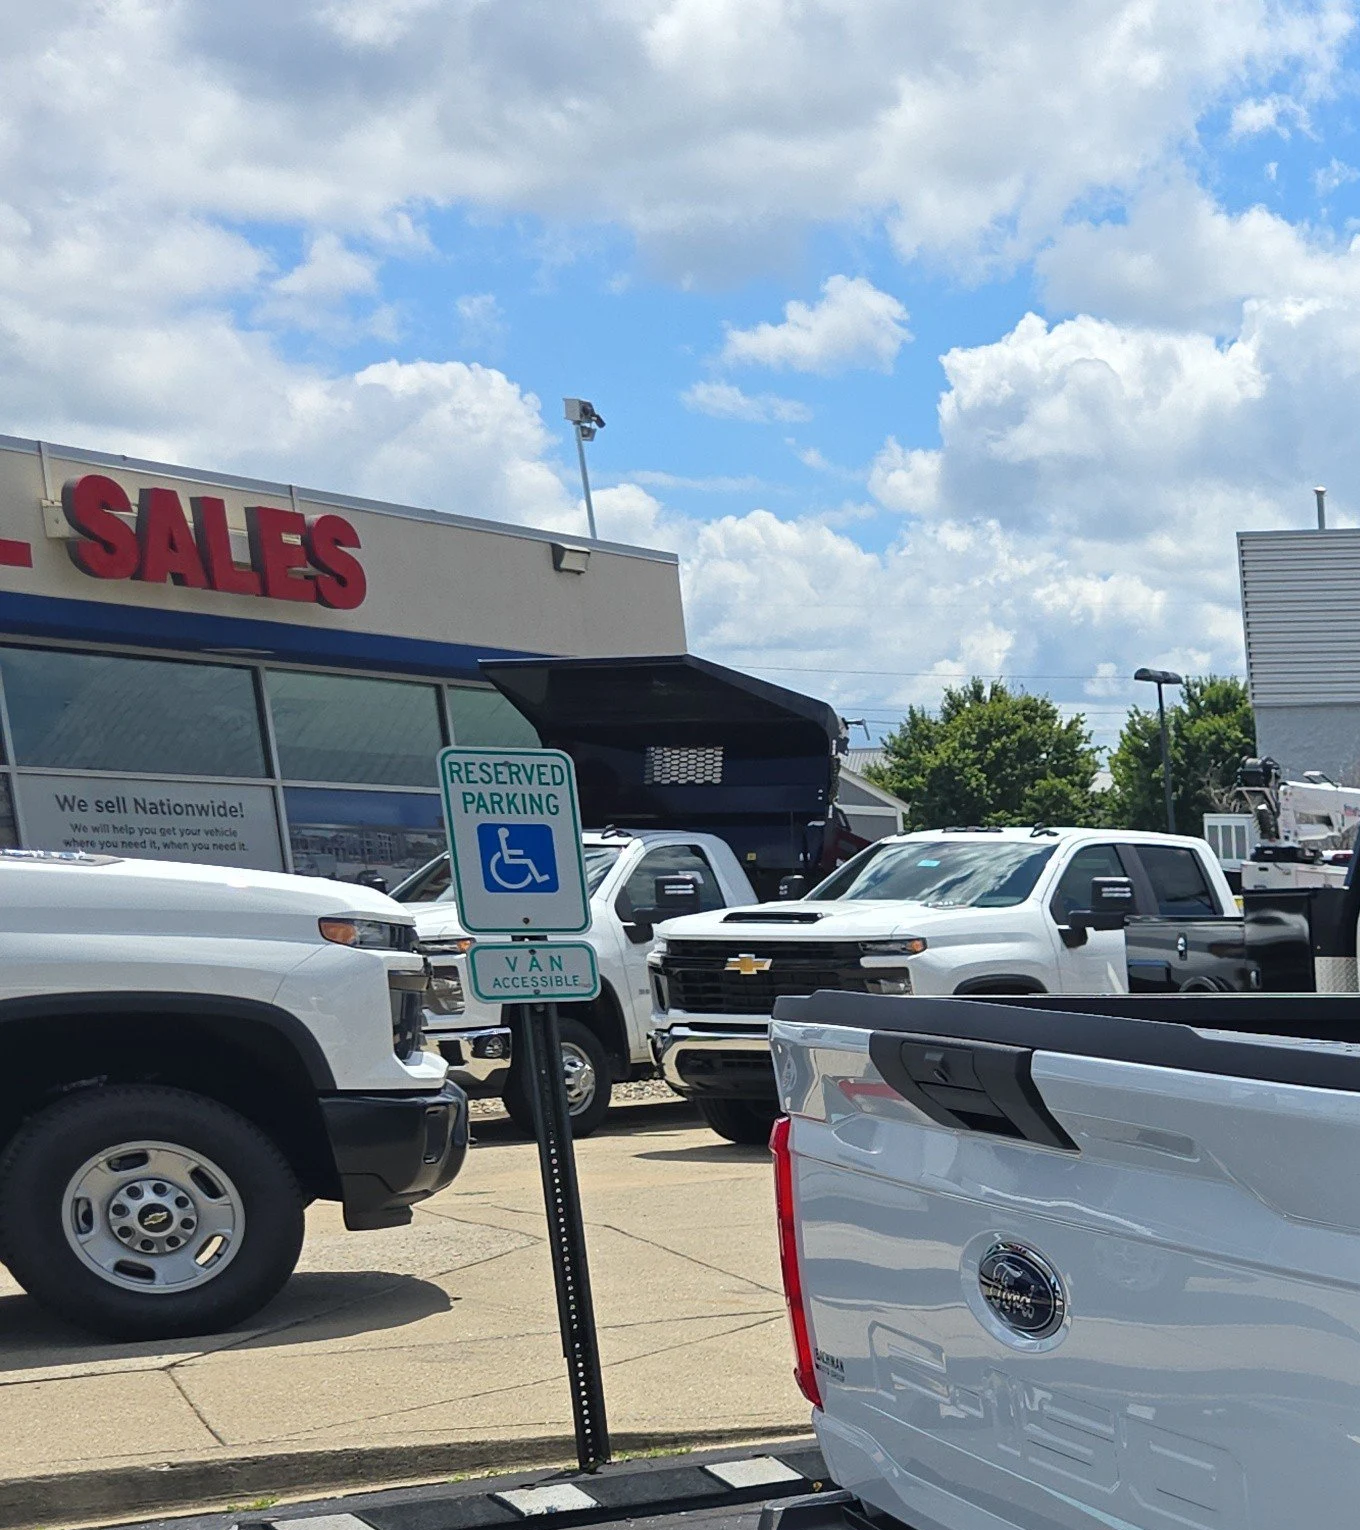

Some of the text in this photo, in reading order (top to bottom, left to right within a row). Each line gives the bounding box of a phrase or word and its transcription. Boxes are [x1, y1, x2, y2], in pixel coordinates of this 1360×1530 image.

[61, 474, 367, 610] SALES
[449, 761, 565, 787] RESERVED
[54, 794, 245, 818] We sell Nationwide!
[462, 791, 560, 816] PARKING
[69, 822, 238, 838] We will help you get your vehicle
[62, 838, 97, 849] where
[99, 840, 119, 851] you
[121, 839, 146, 849] need
[163, 840, 189, 850] when
[191, 842, 210, 852] you
[212, 841, 237, 851] need
[505, 954, 564, 972] VAN
[492, 975, 580, 989] ACCESSIBLE
